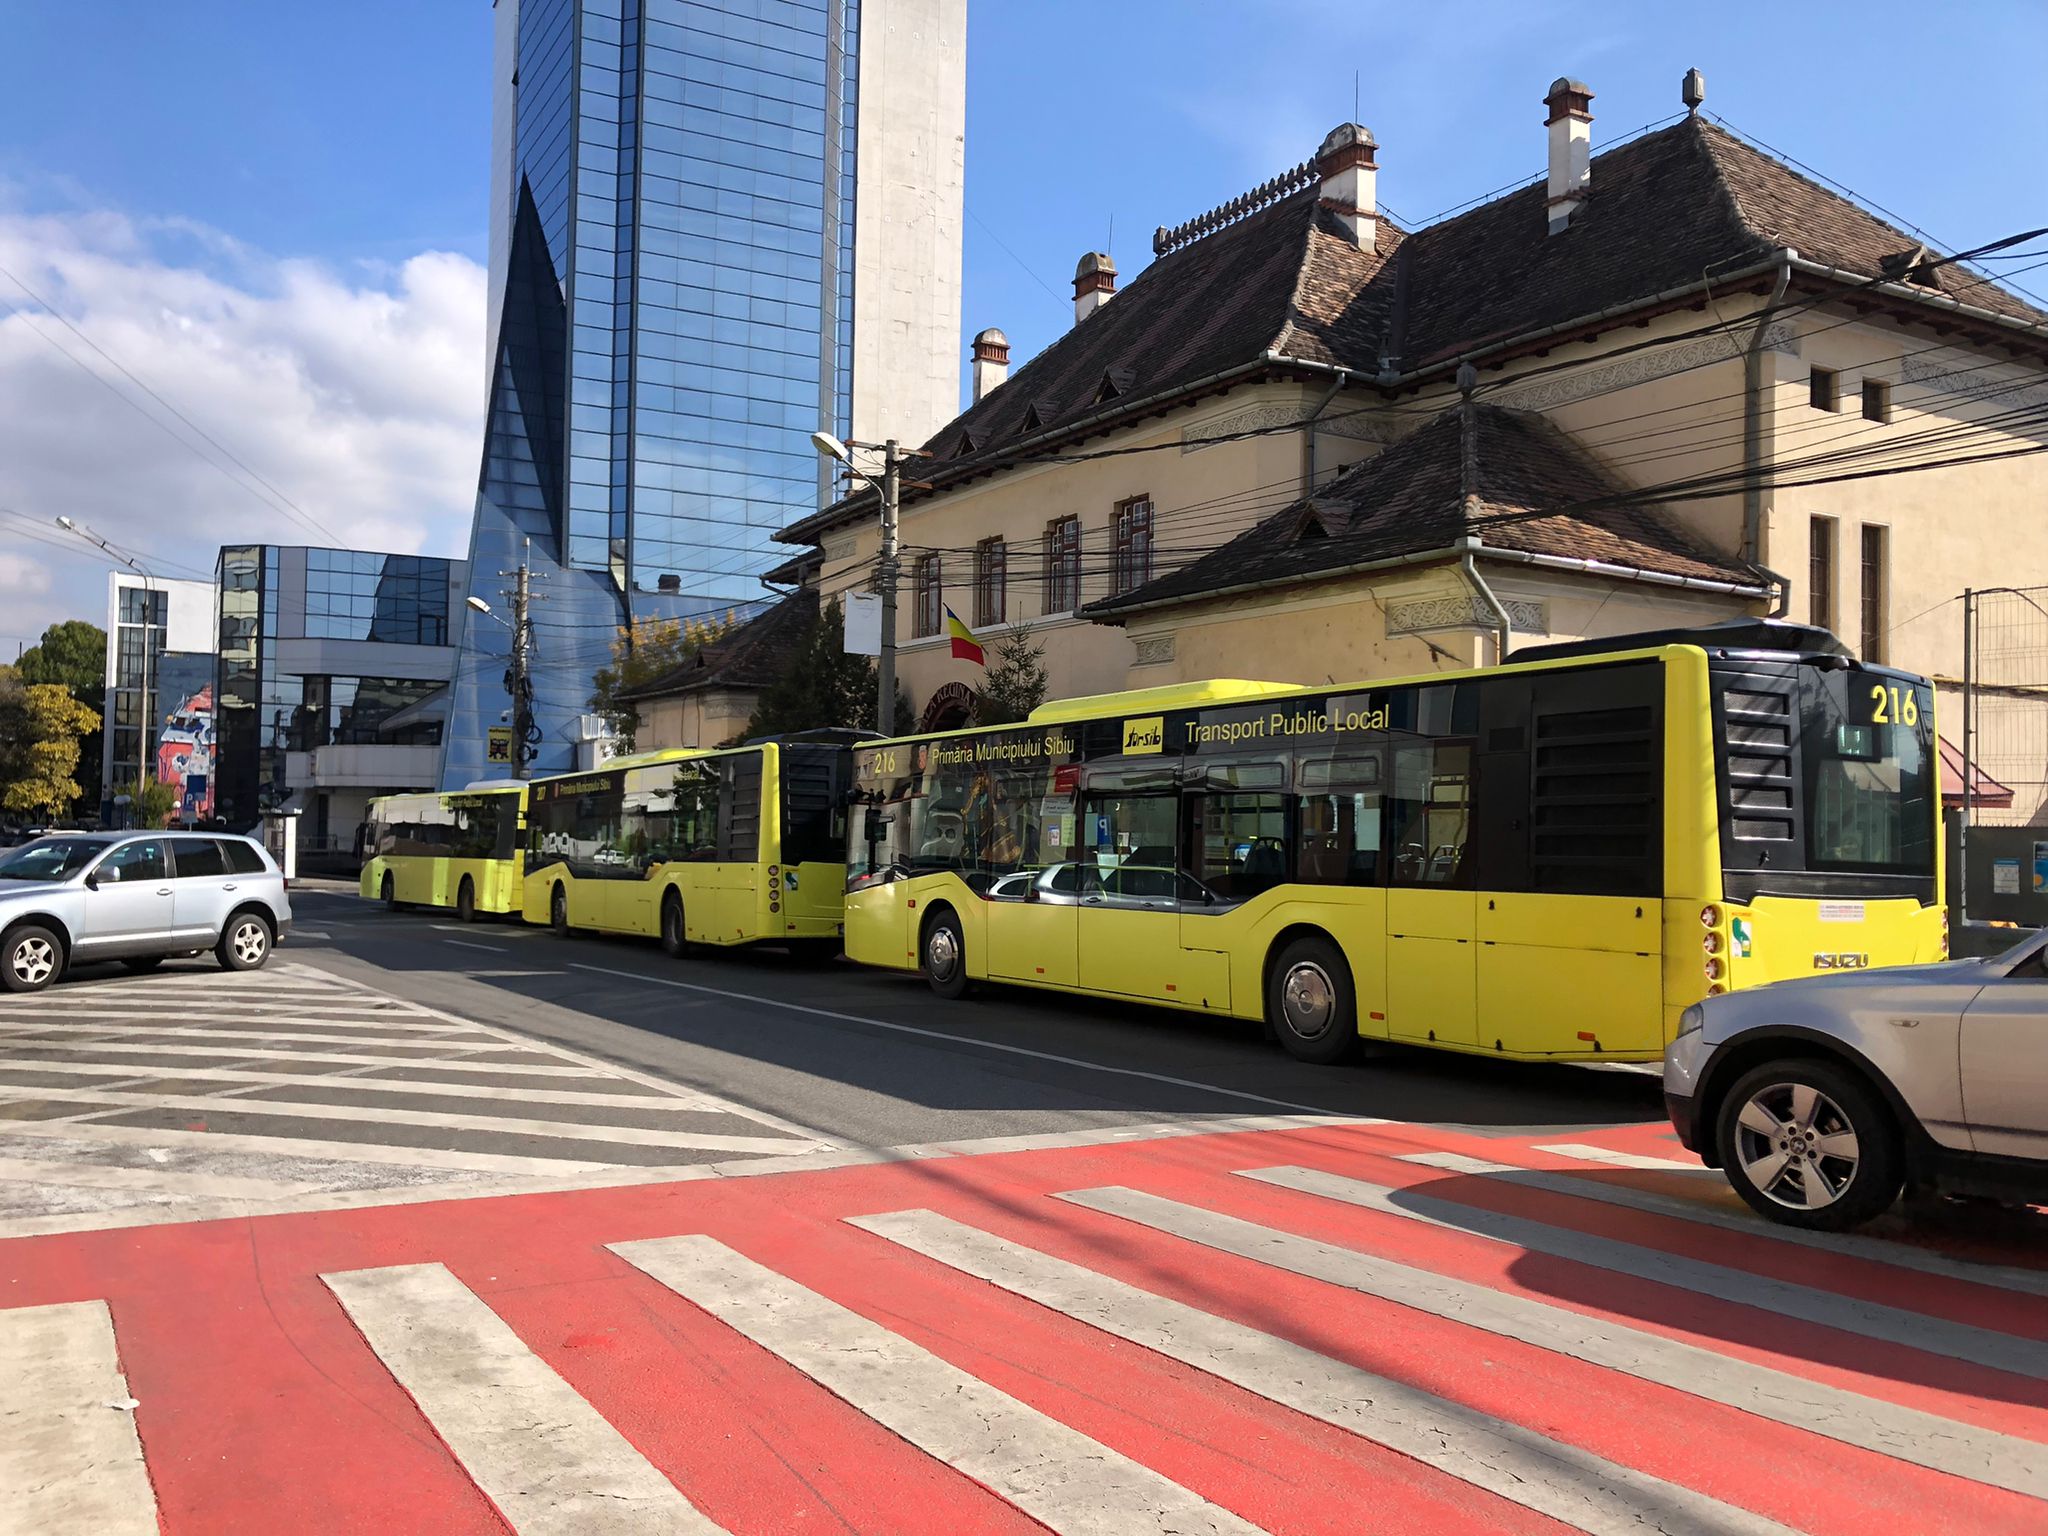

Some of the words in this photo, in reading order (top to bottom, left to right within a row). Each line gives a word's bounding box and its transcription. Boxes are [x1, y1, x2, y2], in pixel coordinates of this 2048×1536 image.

[937, 682, 971, 705] REGINA
[1871, 685, 1918, 726] 216
[1185, 716, 1265, 744] Transport
[1270, 710, 1328, 736] Public
[1334, 703, 1390, 731] Local
[932, 746, 973, 765] Primăria
[976, 737, 1041, 763] Municipiului
[1044, 735, 1075, 756] Sibiu
[874, 752, 896, 774] 216
[186, 793, 194, 805] P
[1813, 952, 1869, 969] ISUZU
